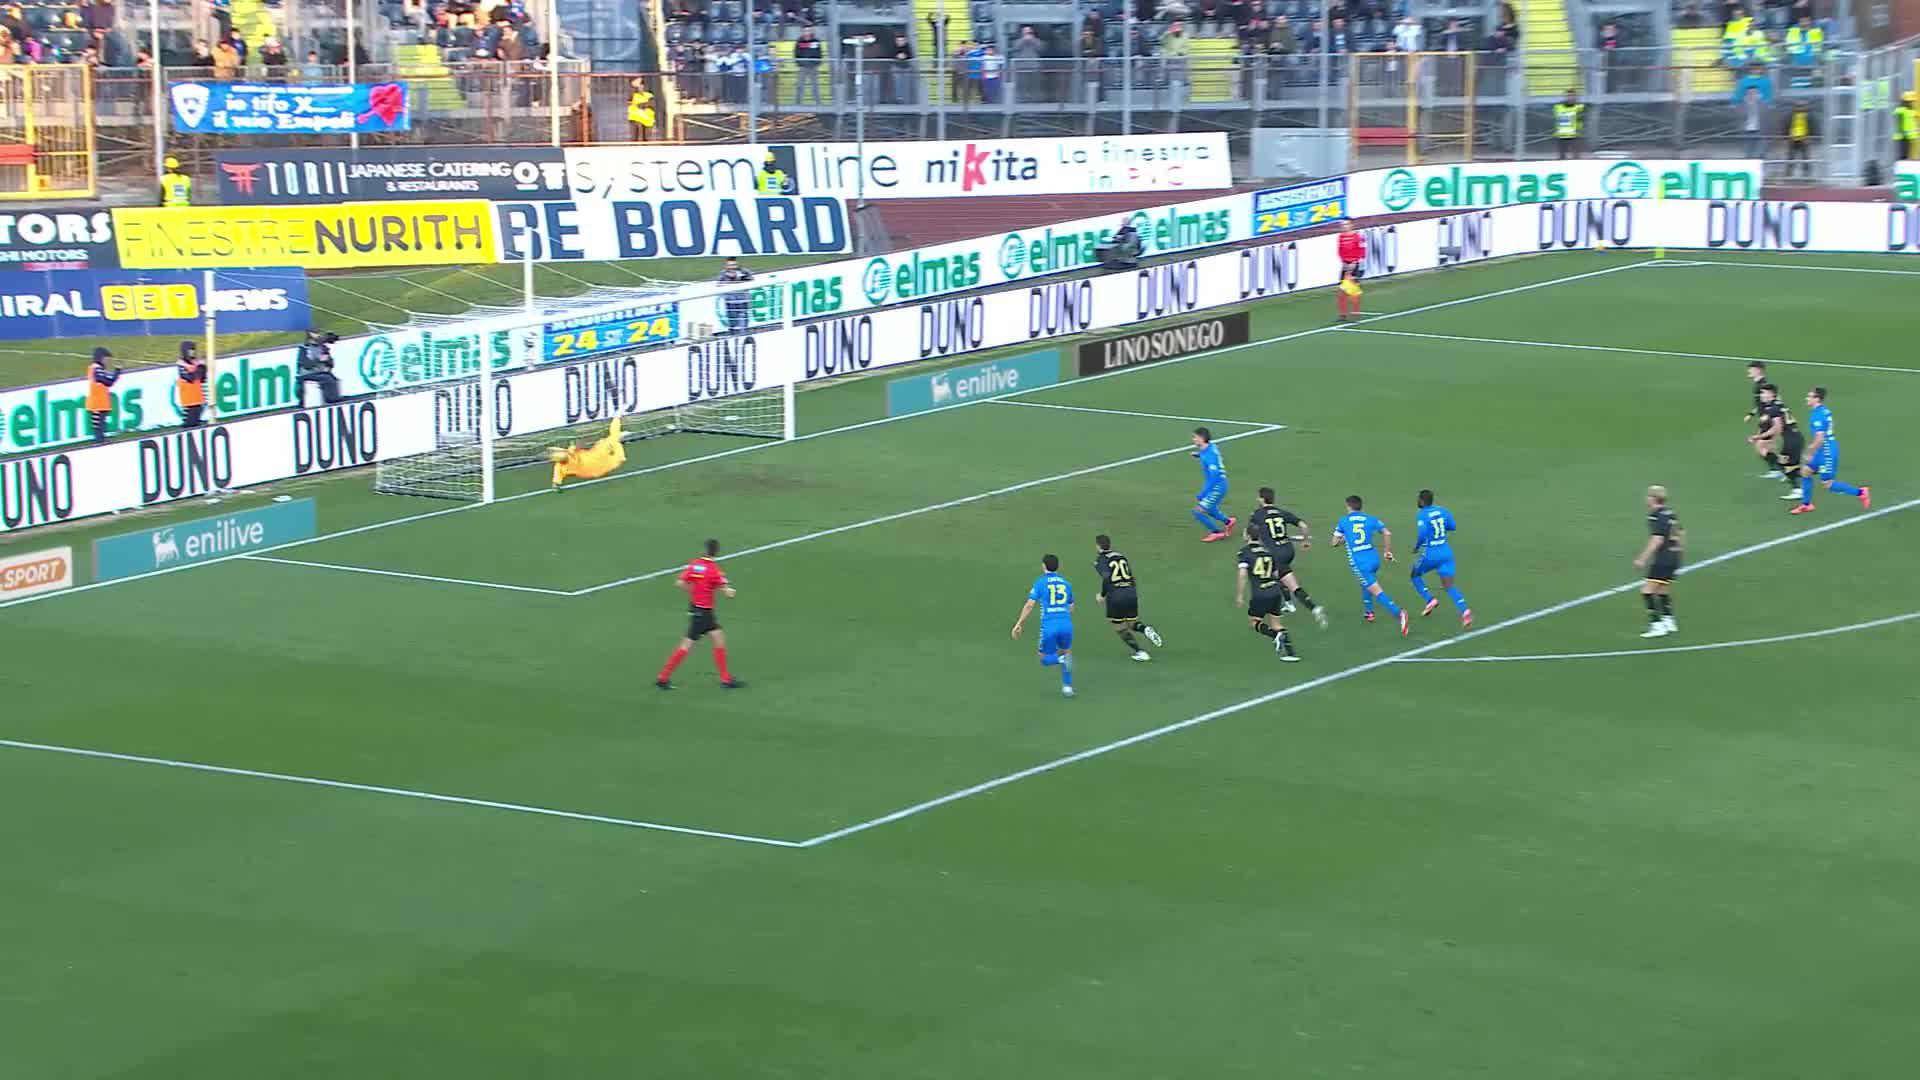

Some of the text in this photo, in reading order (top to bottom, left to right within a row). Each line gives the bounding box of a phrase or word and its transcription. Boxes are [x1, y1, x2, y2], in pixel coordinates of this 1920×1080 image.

[264, 161, 350, 196] TORII
[349, 162, 427, 179] JAPANESE
[428, 161, 513, 178] CATERING
[811, 146, 898, 189] line
[926, 143, 1039, 191] nikita
[1424, 166, 1568, 207] elmas
[496, 197, 848, 261] BE BOARD
[1155, 207, 1231, 252] elmas
[1539, 200, 1631, 250] DUNO
[1708, 200, 1808, 249] DUNO
[896, 251, 981, 299] elmas
[1137, 260, 1200, 321] DUNO
[1239, 240, 1299, 300] DUNO
[0, 290, 100, 317] IRAL
[1029, 279, 1093, 339] DUNO
[552, 331, 600, 357] 24
[626, 317, 672, 343] 24
[805, 315, 873, 379] DUNO
[920, 296, 985, 359] DUNO
[1103, 320, 1224, 370] LINO SONEGO
[400, 330, 512, 382] elms
[686, 335, 757, 403] DUNO
[564, 356, 639, 425] DUNO
[956, 365, 1020, 399] enilive
[292, 400, 378, 474] DUNO
[139, 426, 233, 503] DUNO
[184, 517, 265, 558] enilive
[1264, 516, 1288, 539] 13
[1351, 522, 1367, 546] 5
[1430, 516, 1446, 539] 11
[4, 560, 61, 588] SPORT
[1108, 559, 1131, 583] 20
[1252, 555, 1274, 579] 47
[1047, 583, 1069, 606] 13
